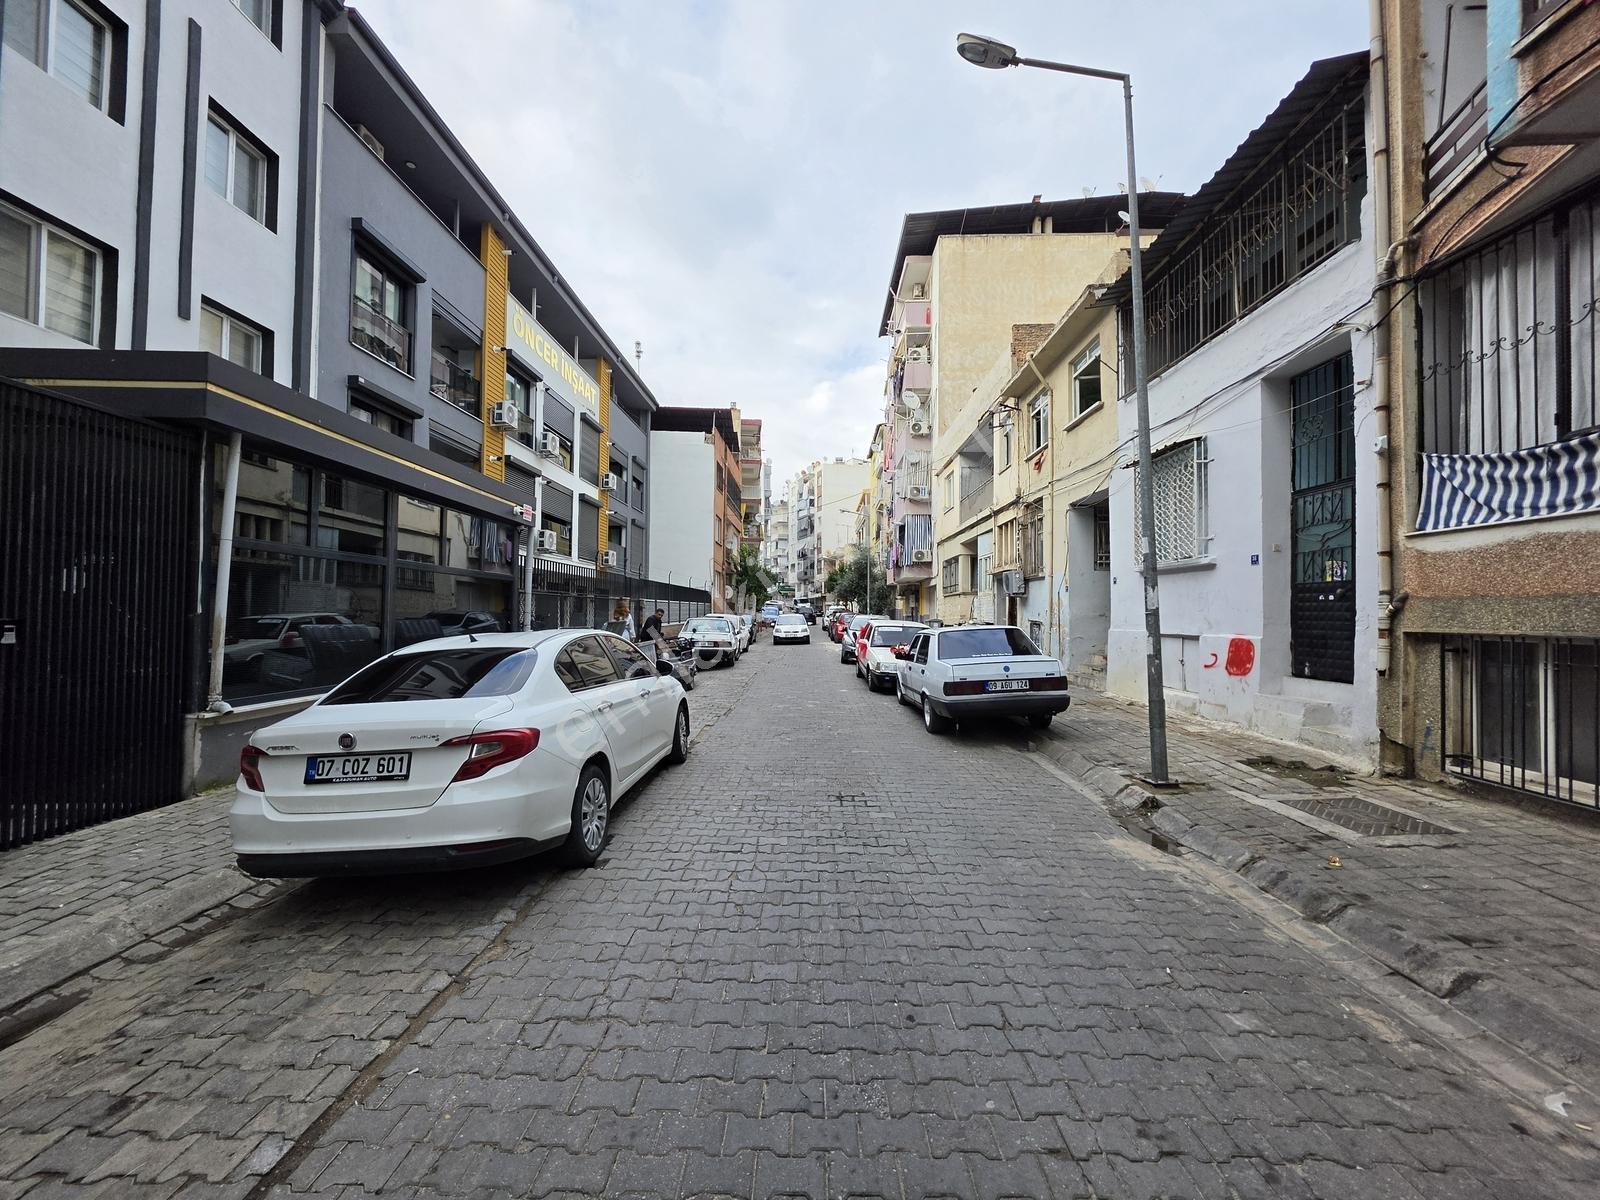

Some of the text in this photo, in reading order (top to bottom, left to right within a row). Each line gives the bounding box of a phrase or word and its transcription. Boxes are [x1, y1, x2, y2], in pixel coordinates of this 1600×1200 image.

[513, 303, 597, 406] ÖNCER İNŞAAT
[989, 681, 998, 690] 09
[1001, 681, 1013, 689] AGU
[1016, 680, 1028, 688] 124
[316, 755, 405, 777] 07 COZ 601
